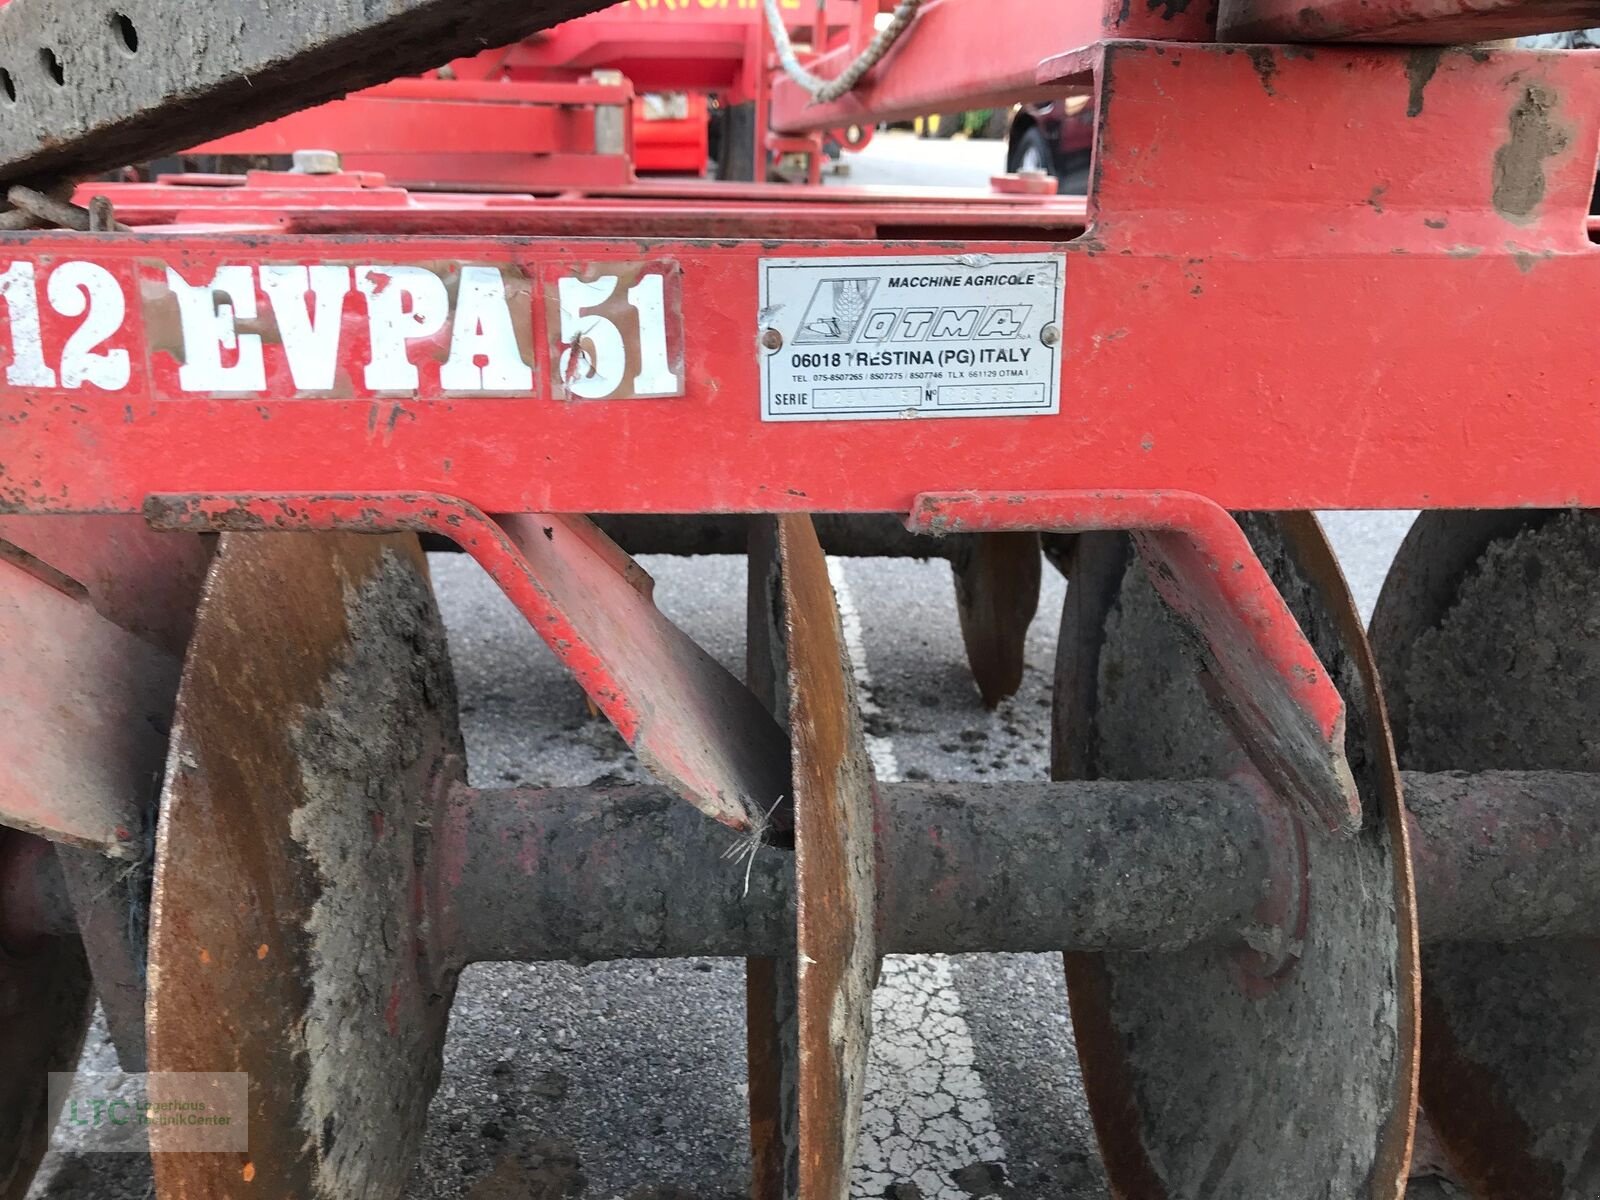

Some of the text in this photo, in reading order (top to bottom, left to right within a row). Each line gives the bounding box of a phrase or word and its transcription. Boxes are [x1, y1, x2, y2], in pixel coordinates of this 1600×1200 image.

[888, 274, 1036, 288] MACCHINE AGRICOLE
[0, 261, 679, 398] 12 EVPA 51
[863, 308, 1023, 339] OTMA
[791, 347, 1032, 368] 06018 TRESTINA (PG) ITALY
[813, 373, 863, 381] 075-8507265
[909, 371, 943, 379] 8507746
[999, 369, 1024, 377] OTMA
[775, 393, 808, 406] SERIE
